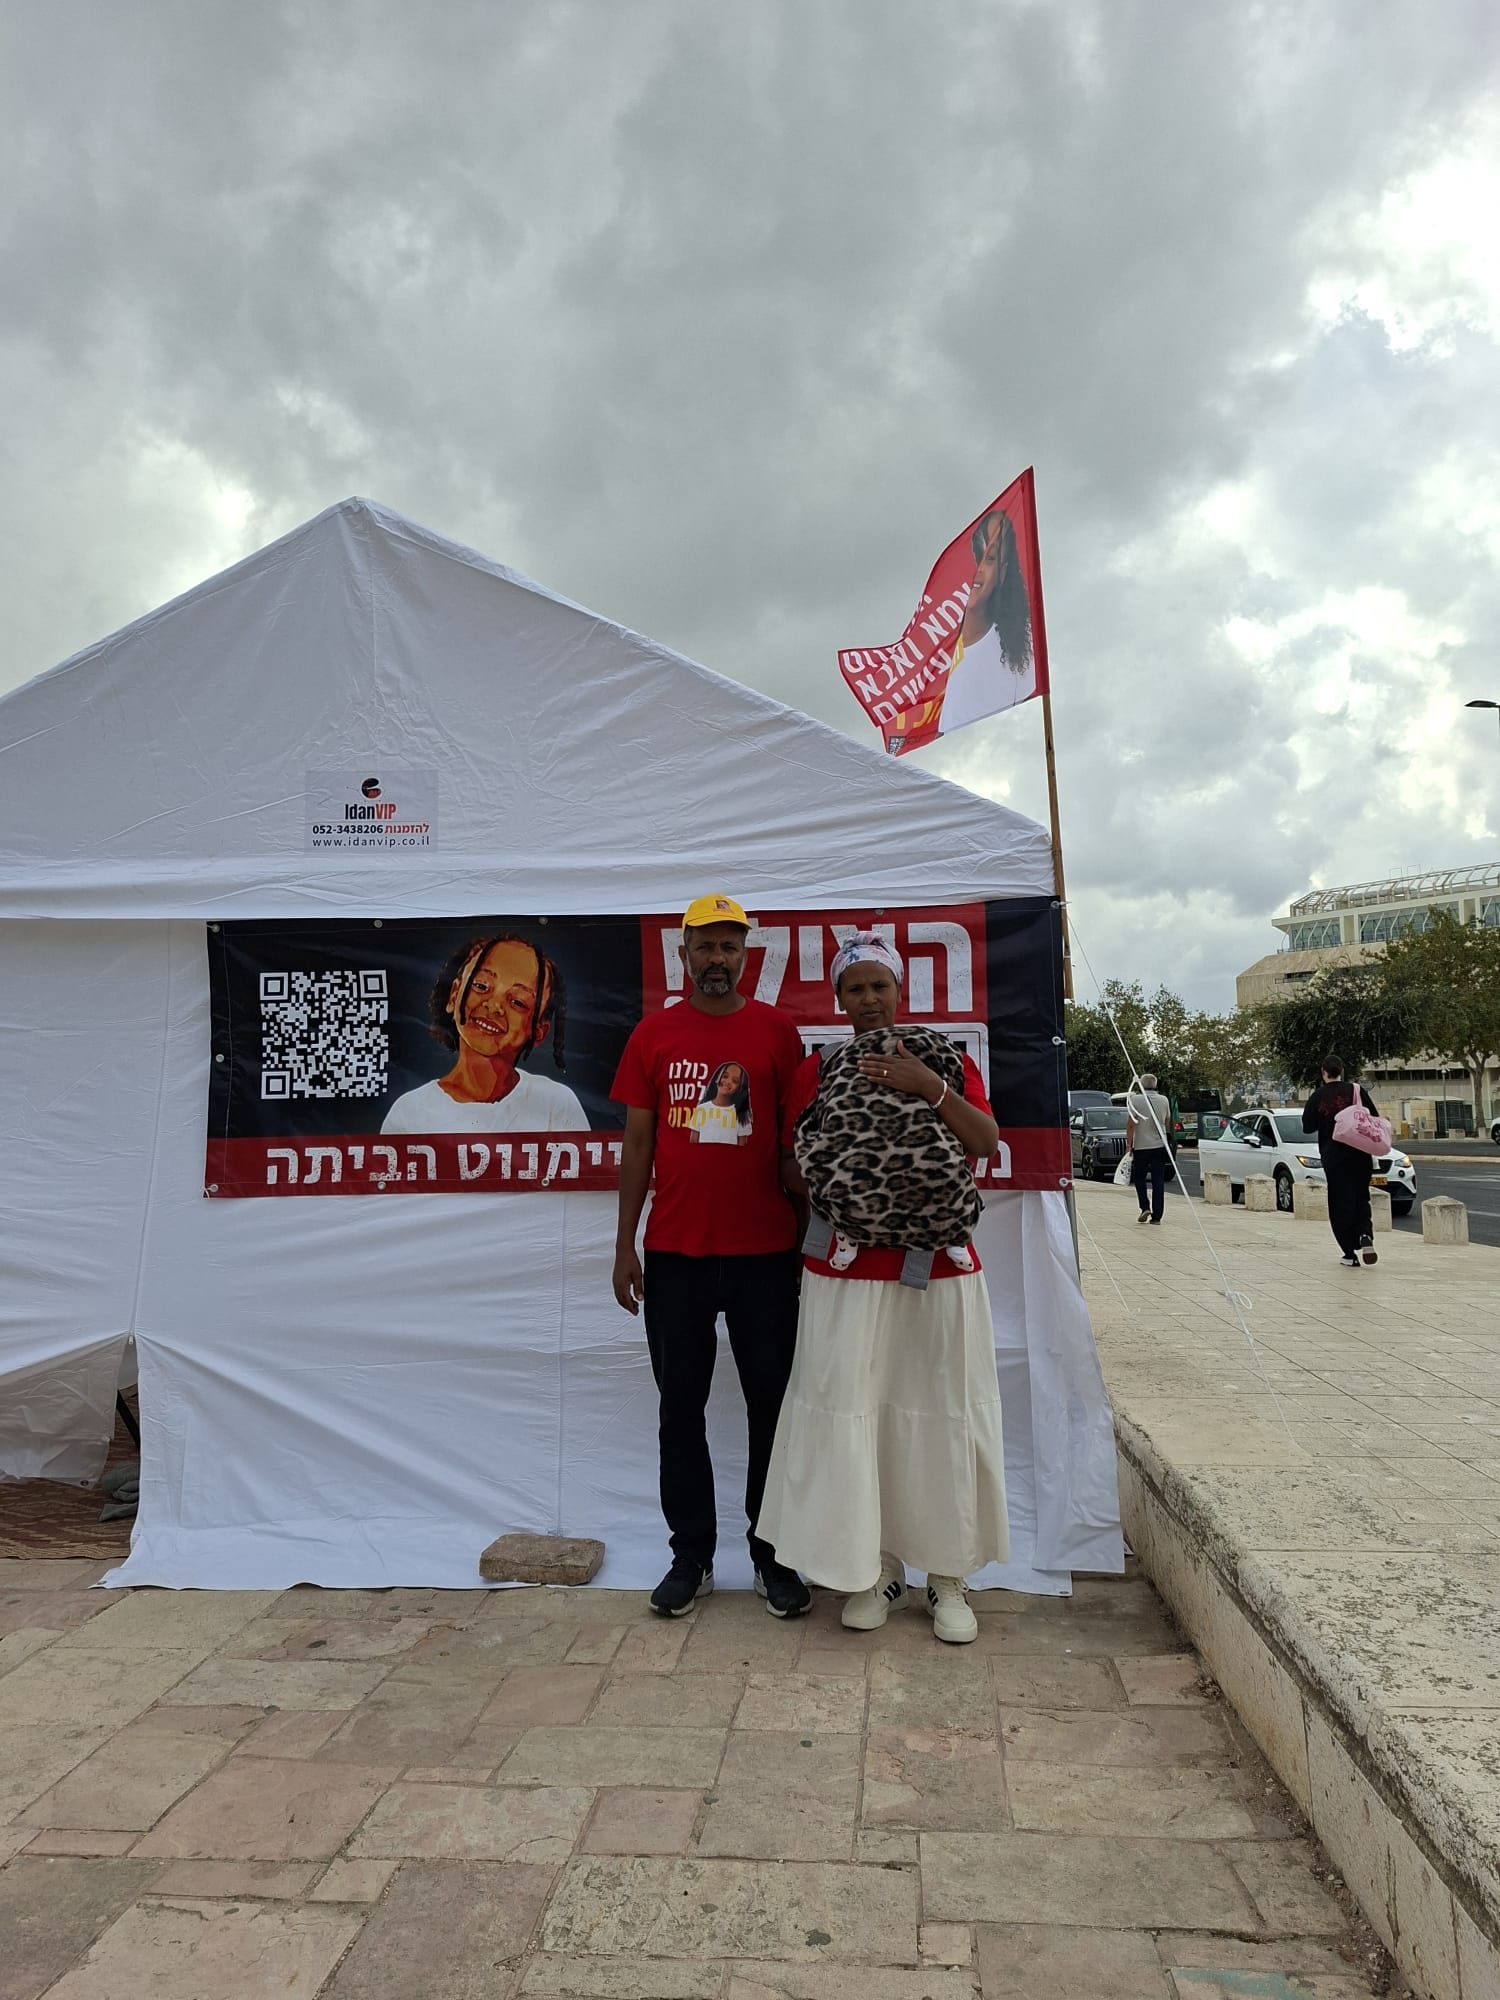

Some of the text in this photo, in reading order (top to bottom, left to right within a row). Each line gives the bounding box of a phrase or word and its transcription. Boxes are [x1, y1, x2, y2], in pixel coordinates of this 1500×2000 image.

[919, 582, 973, 646] אמא
[855, 637, 924, 703] ואבא
[345, 803, 397, 820] IdanVIP
[312, 823, 430, 834] להזמנות 052-3438206
[312, 836, 430, 848] www.idanvip.co.il
[668, 1059, 709, 1080] כולנו
[668, 1080, 707, 1105] למען
[266, 1142, 656, 1185] יימנוט הביתה
